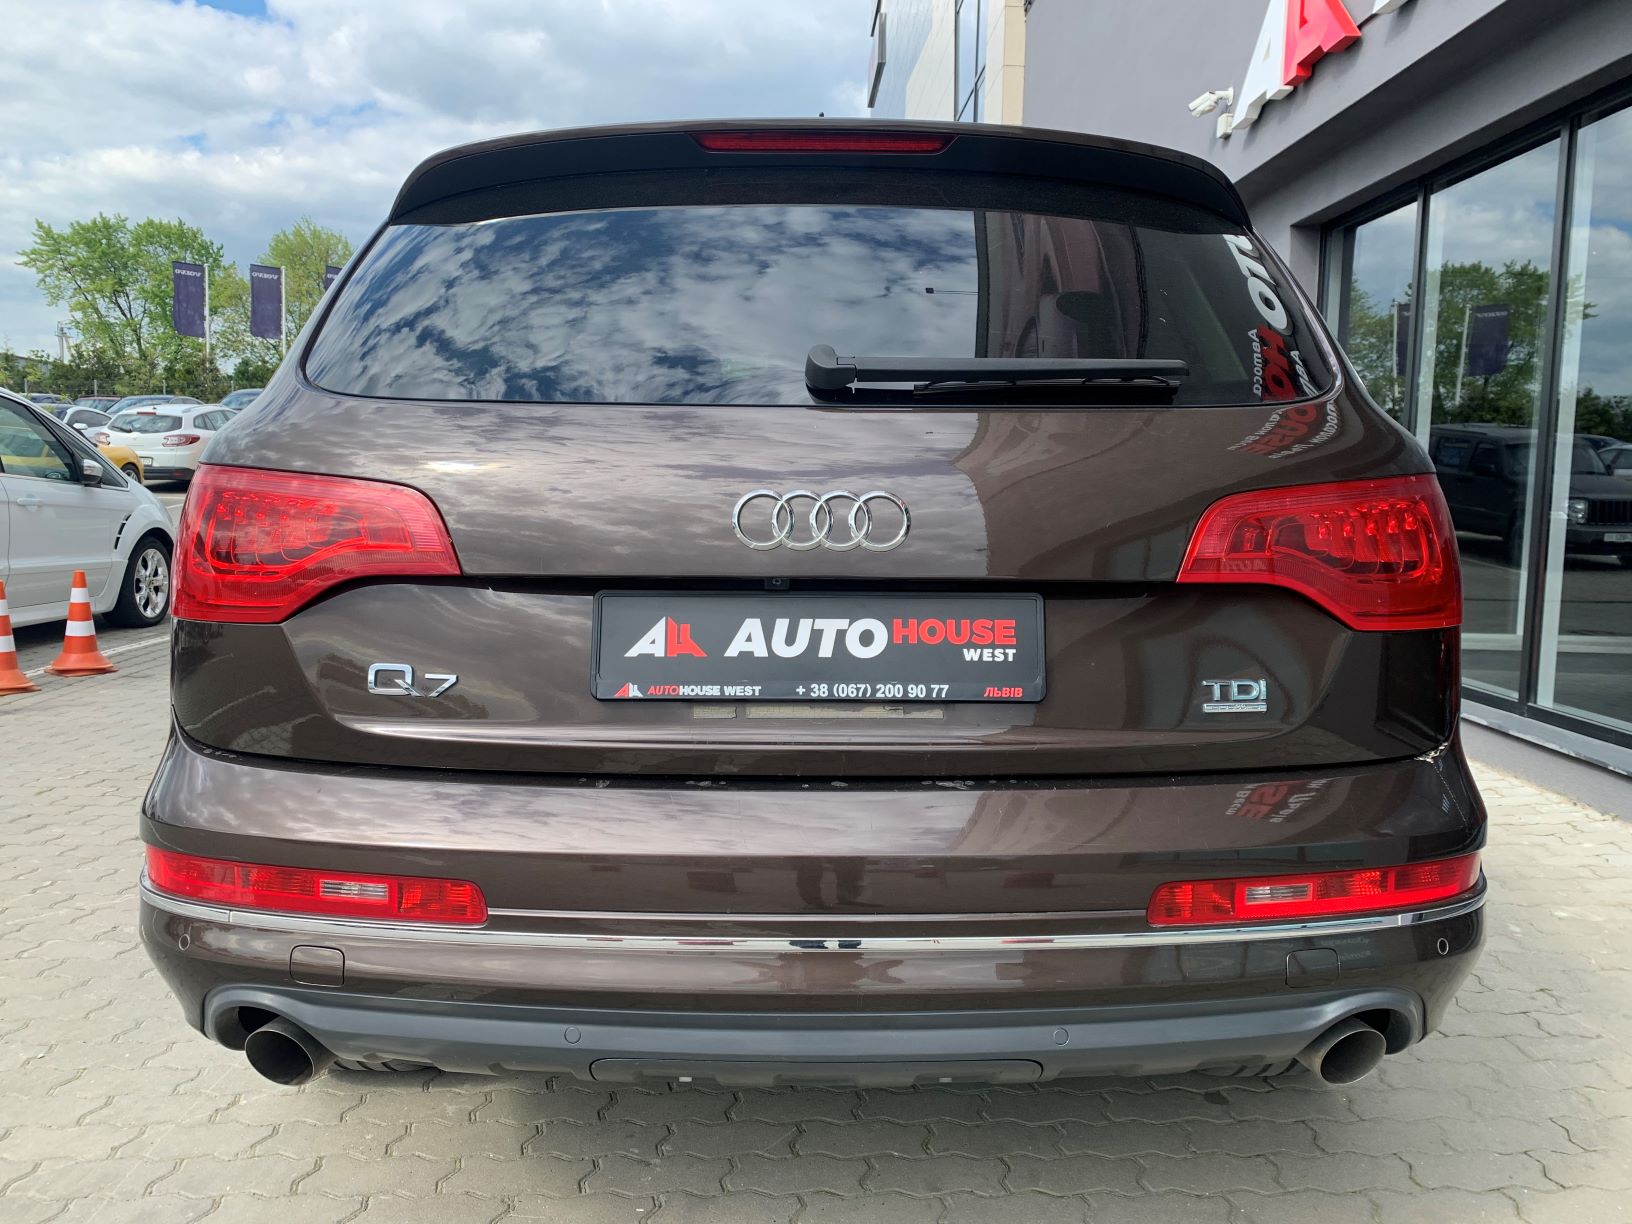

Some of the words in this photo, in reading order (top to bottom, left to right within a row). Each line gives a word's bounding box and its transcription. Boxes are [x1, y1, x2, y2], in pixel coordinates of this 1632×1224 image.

[724, 617, 889, 659] AUTO
[892, 617, 1017, 646] HOUSE
[962, 648, 1017, 662] WEST
[367, 662, 459, 697] Q7
[723, 685, 762, 697] WEST
[810, 683, 829, 697] 38
[833, 683, 872, 698] (067)
[875, 683, 904, 698] 200
[907, 684, 926, 698] 90
[930, 684, 950, 698] 77
[983, 686, 1024, 699] ЛЬВІВ
[1202, 679, 1267, 701] TDI
